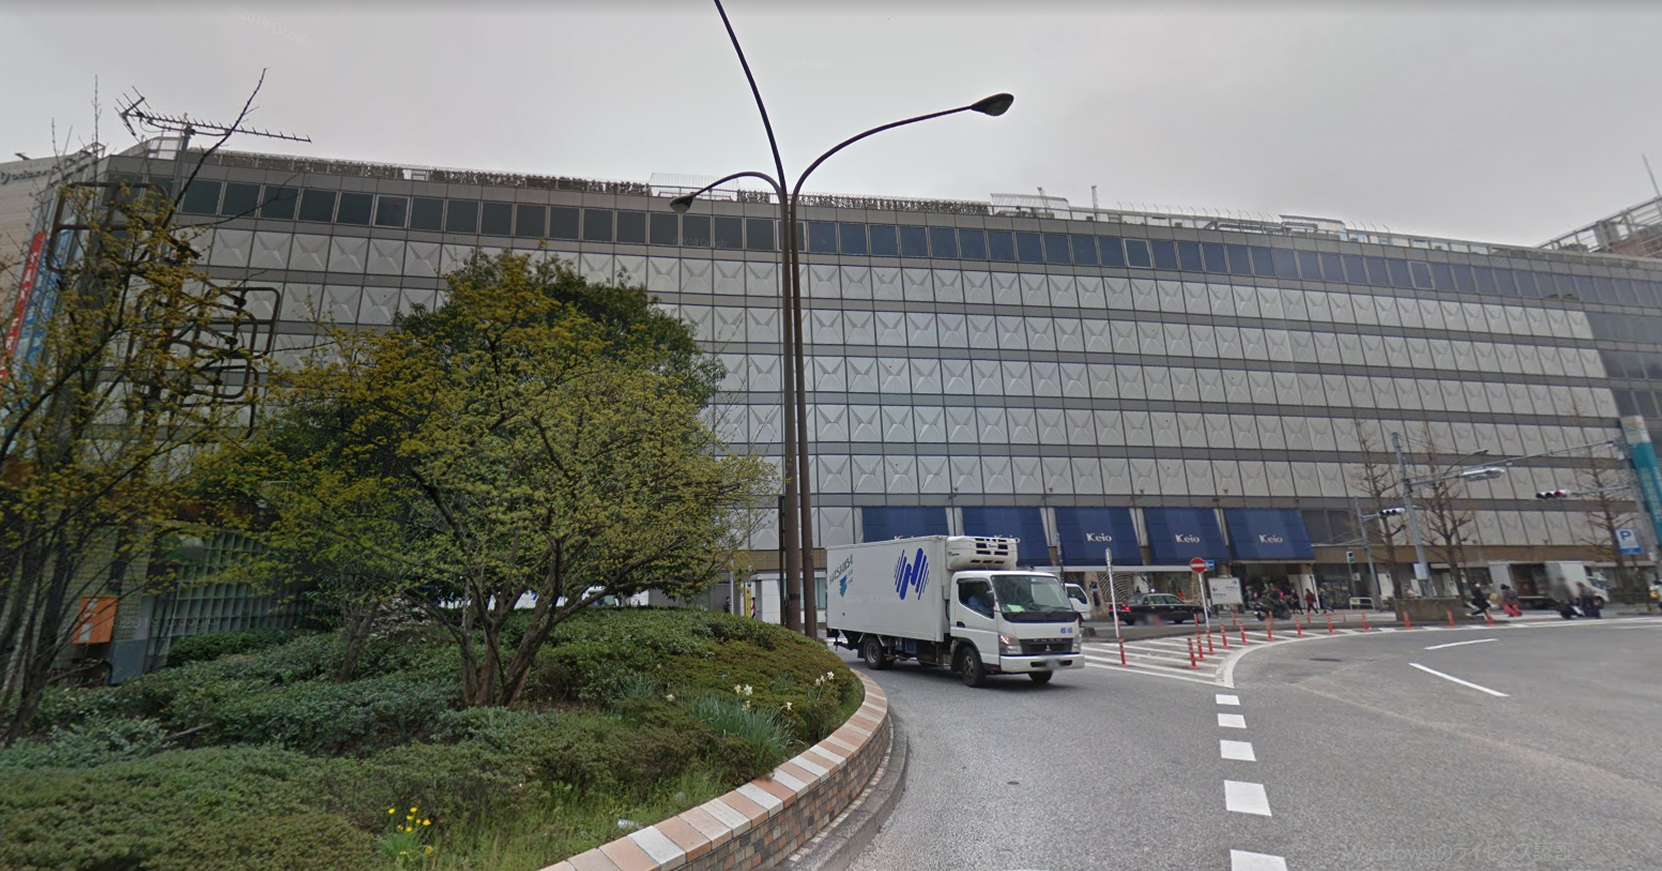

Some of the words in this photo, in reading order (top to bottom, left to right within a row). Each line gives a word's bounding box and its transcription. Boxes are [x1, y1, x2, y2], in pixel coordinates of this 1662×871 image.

[1086, 532, 1112, 542] Keio
[1175, 534, 1200, 543] Keio
[1259, 534, 1283, 543] Keio
[1620, 530, 1632, 541] P
